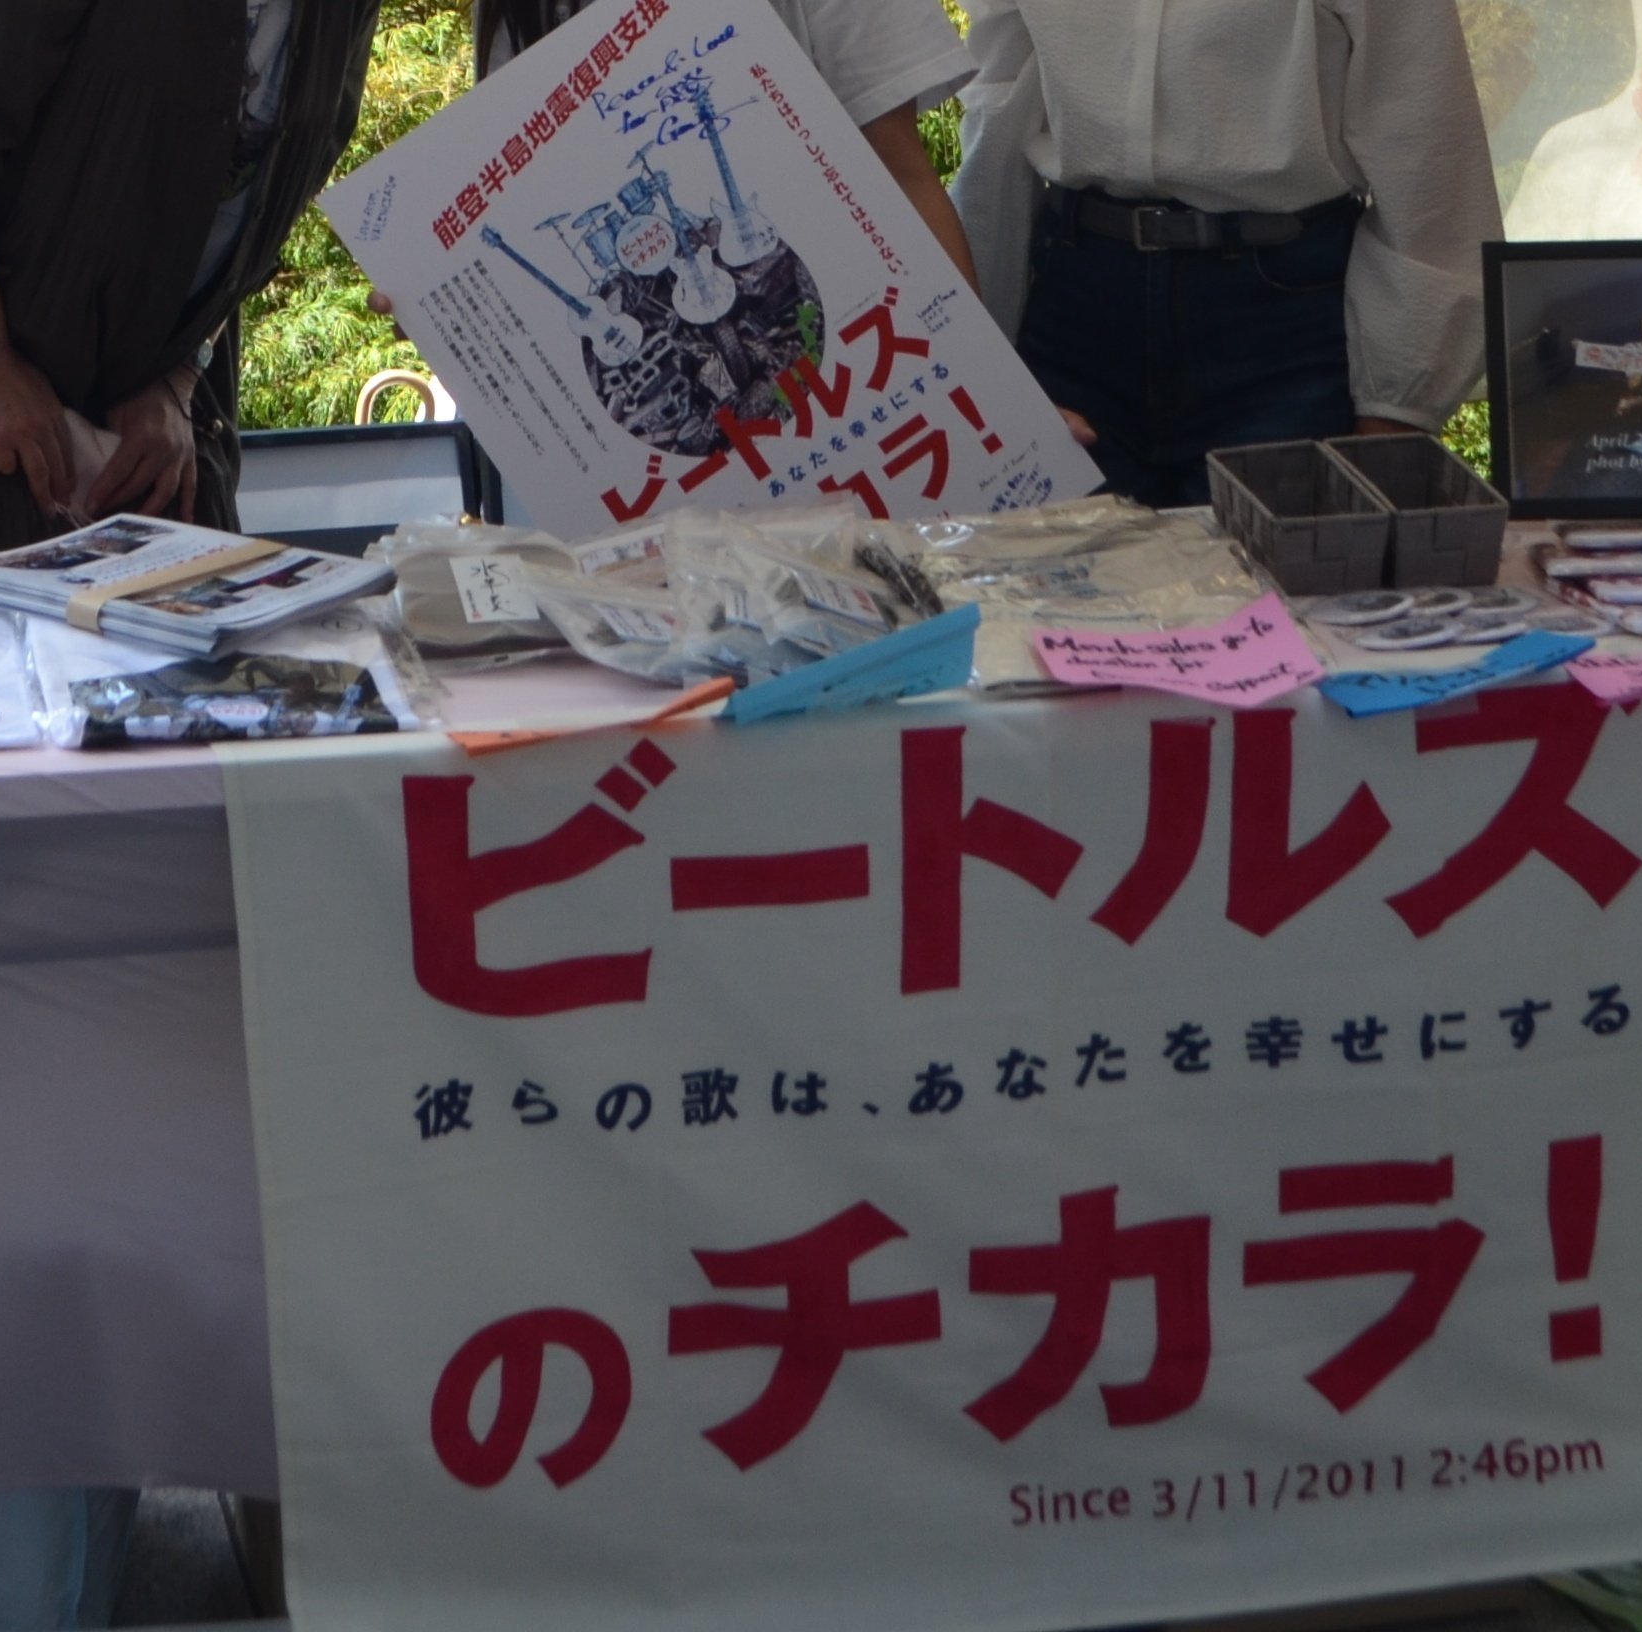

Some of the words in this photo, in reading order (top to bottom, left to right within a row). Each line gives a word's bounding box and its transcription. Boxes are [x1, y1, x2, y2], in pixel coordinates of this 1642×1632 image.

[600, 286, 931, 524] ビートルズ
[413, 981, 1632, 1141] 彼らの歌は、あなたを幸せにする
[428, 1133, 1603, 1491] のチカラ!
[1007, 1475, 1135, 1529] Since
[1150, 1448, 1411, 1524] 3/11/2011
[1427, 1430, 1607, 1493] 2:46pm
